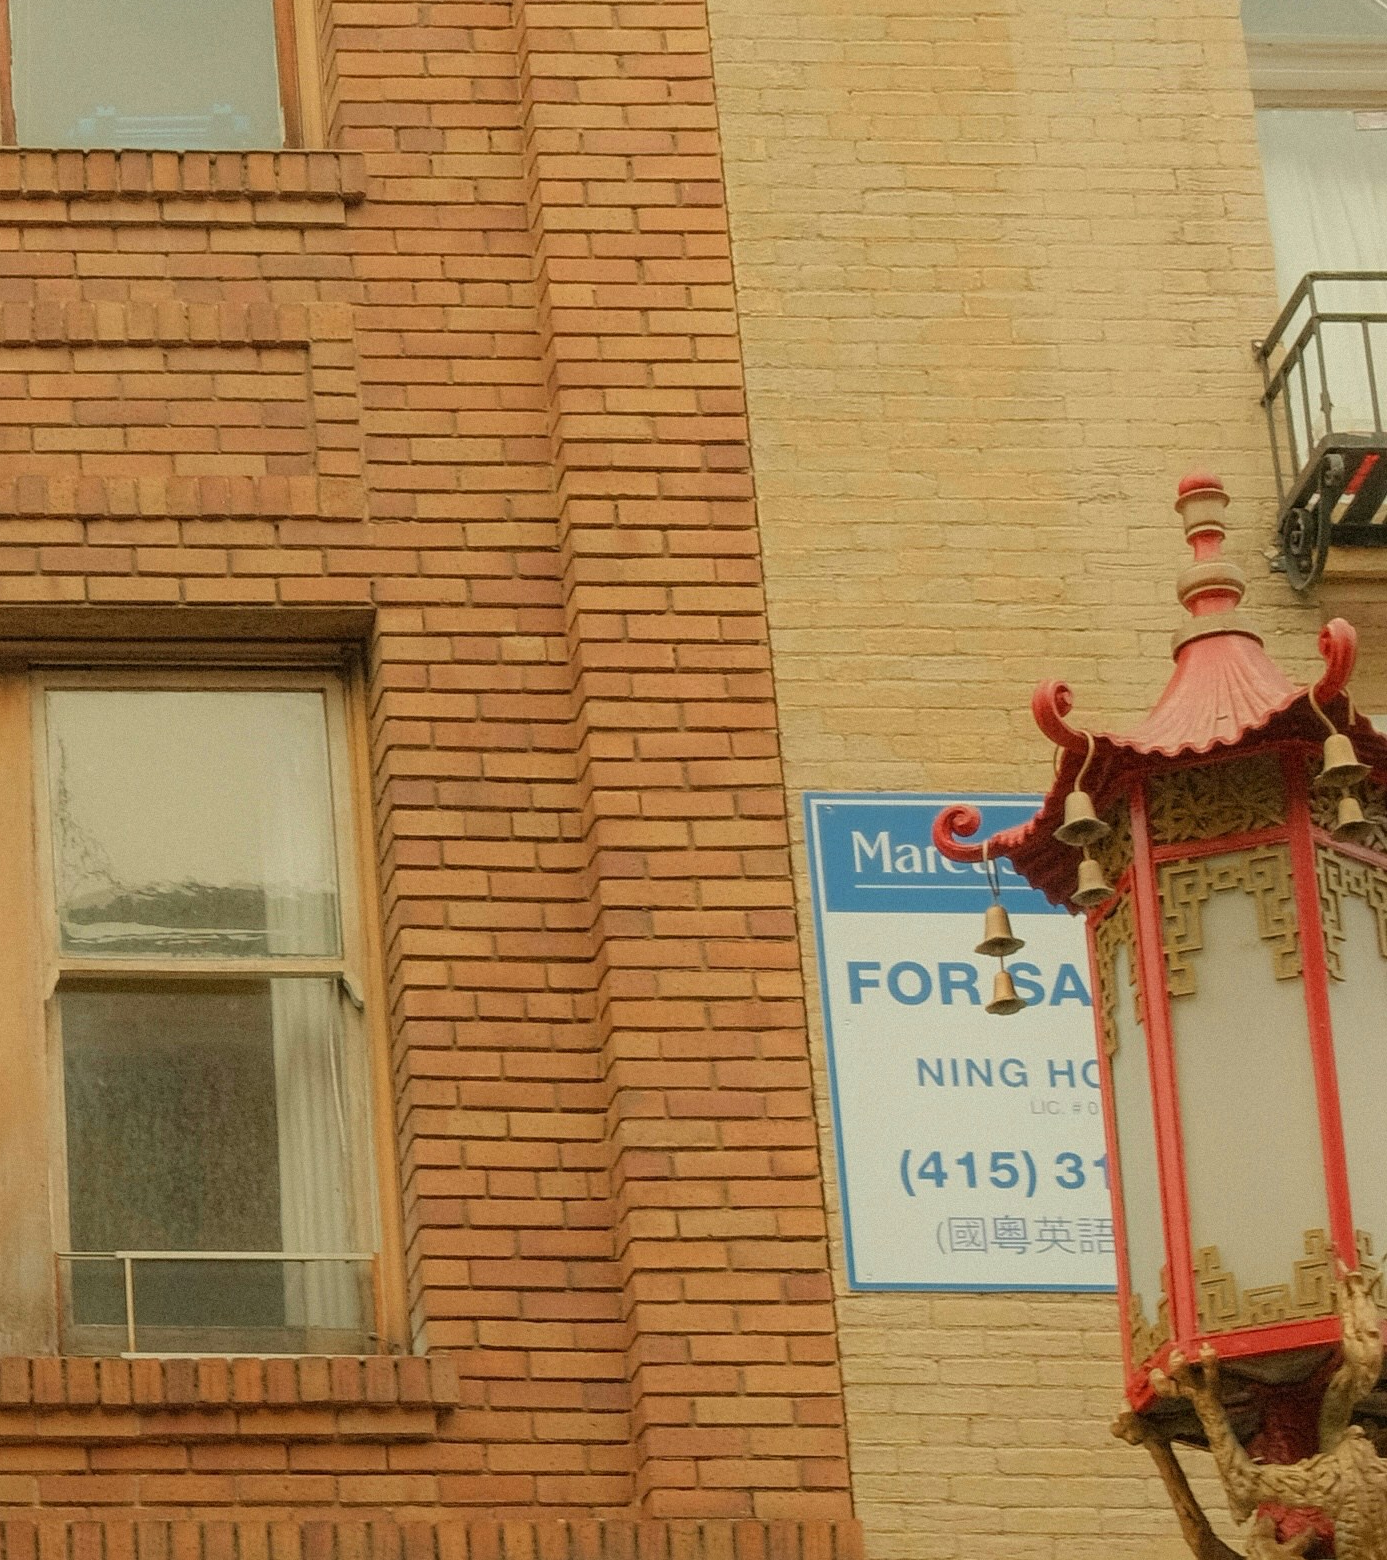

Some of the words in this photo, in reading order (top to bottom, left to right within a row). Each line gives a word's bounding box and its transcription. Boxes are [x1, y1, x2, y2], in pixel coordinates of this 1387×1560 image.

[846, 960, 982, 1006] FOR
[916, 1057, 1028, 1088] NING
[899, 1148, 1037, 1198] (415)
